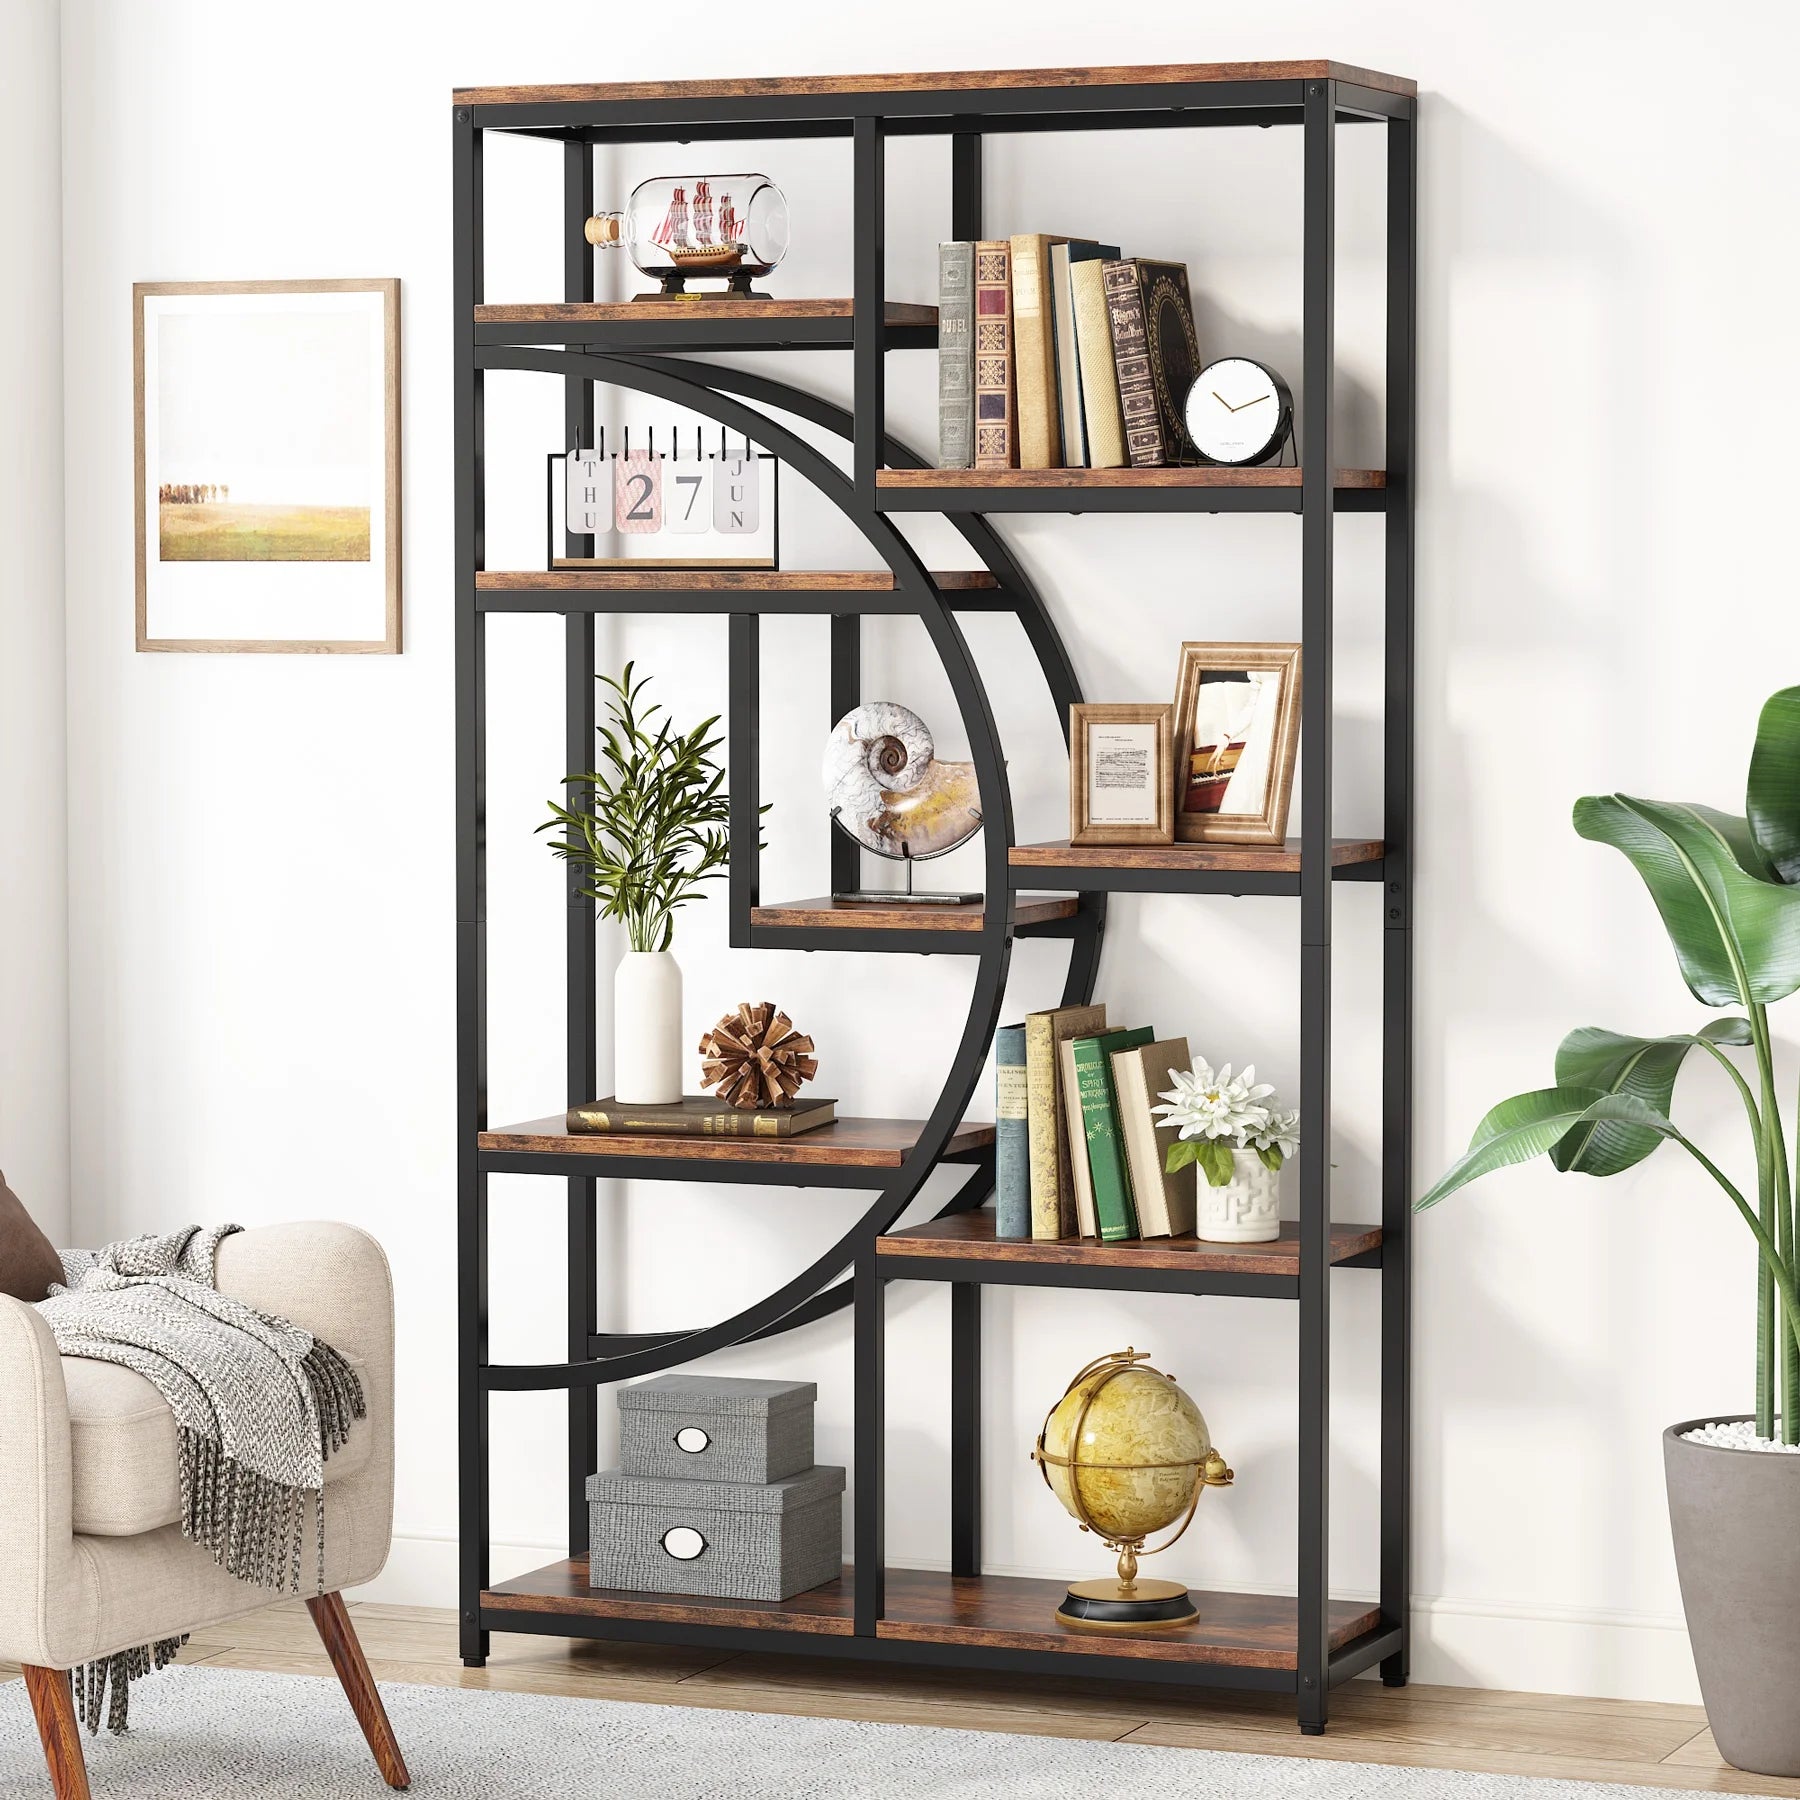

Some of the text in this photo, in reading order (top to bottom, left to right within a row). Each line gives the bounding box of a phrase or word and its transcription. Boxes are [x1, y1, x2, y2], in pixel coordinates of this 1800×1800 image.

[583, 461, 597, 529] THU
[730, 459, 744, 528] JUN
[1081, 1078, 1104, 1089] SPIRIT
